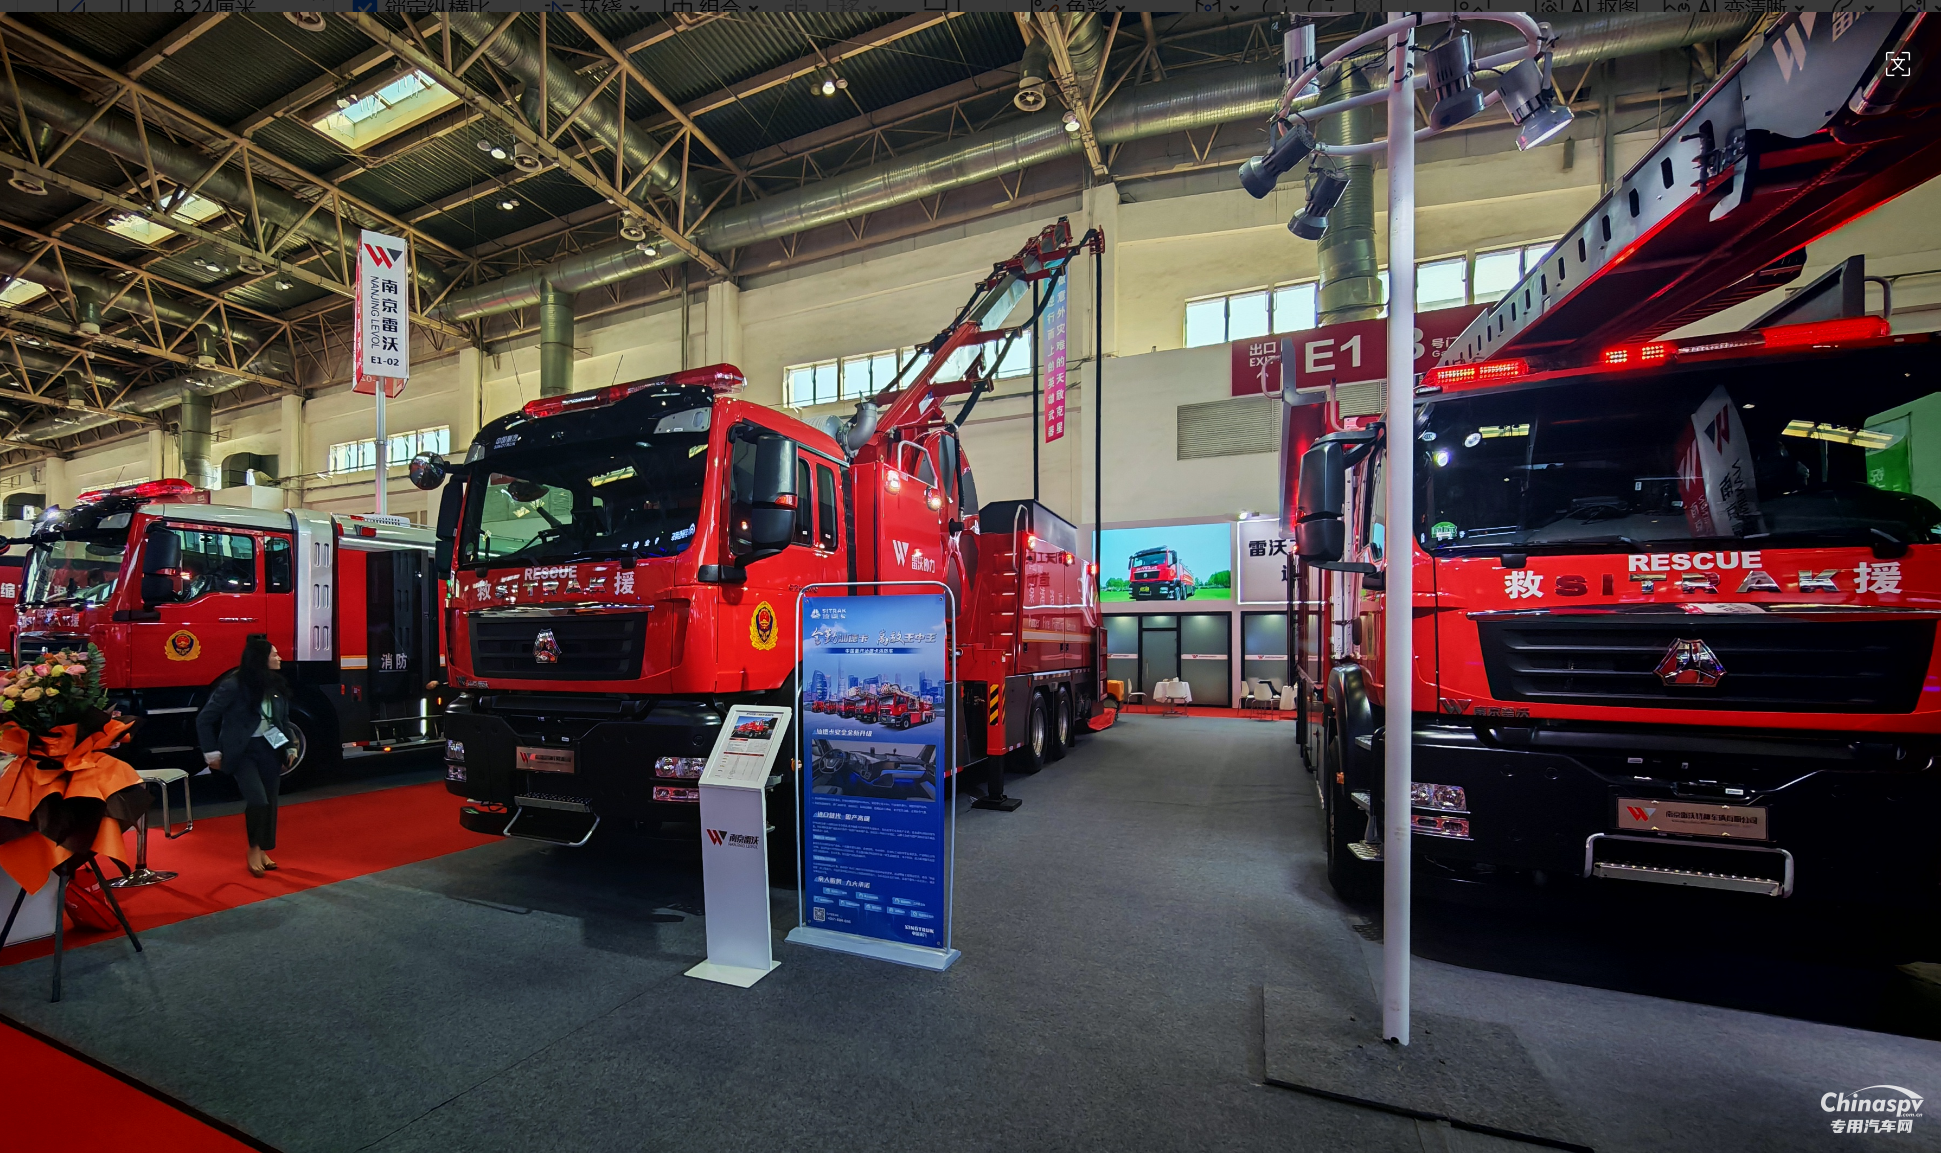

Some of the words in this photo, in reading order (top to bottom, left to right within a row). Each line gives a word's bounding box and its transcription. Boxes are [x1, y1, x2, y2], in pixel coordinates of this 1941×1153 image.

[370, 275, 380, 317] NANJING
[382, 279, 399, 352] 南京雷沃
[370, 318, 380, 349] LEVOL
[1249, 341, 1277, 356] 出口
[1305, 335, 1361, 373] E1
[370, 356, 400, 366] E1-02
[1248, 539, 1296, 557] 雷沃
[1627, 551, 1762, 572] RESCUE
[524, 565, 578, 580] RESCUE
[1503, 570, 1545, 599] 救
[1554, 569, 1842, 596] SITRAK
[1853, 561, 1903, 595] 援
[0, 583, 16, 599] 缩
[476, 580, 493, 602] 救
[614, 571, 635, 595] 援
[380, 653, 408, 670] 消防
[729, 833, 760, 845] 南京雷沃
